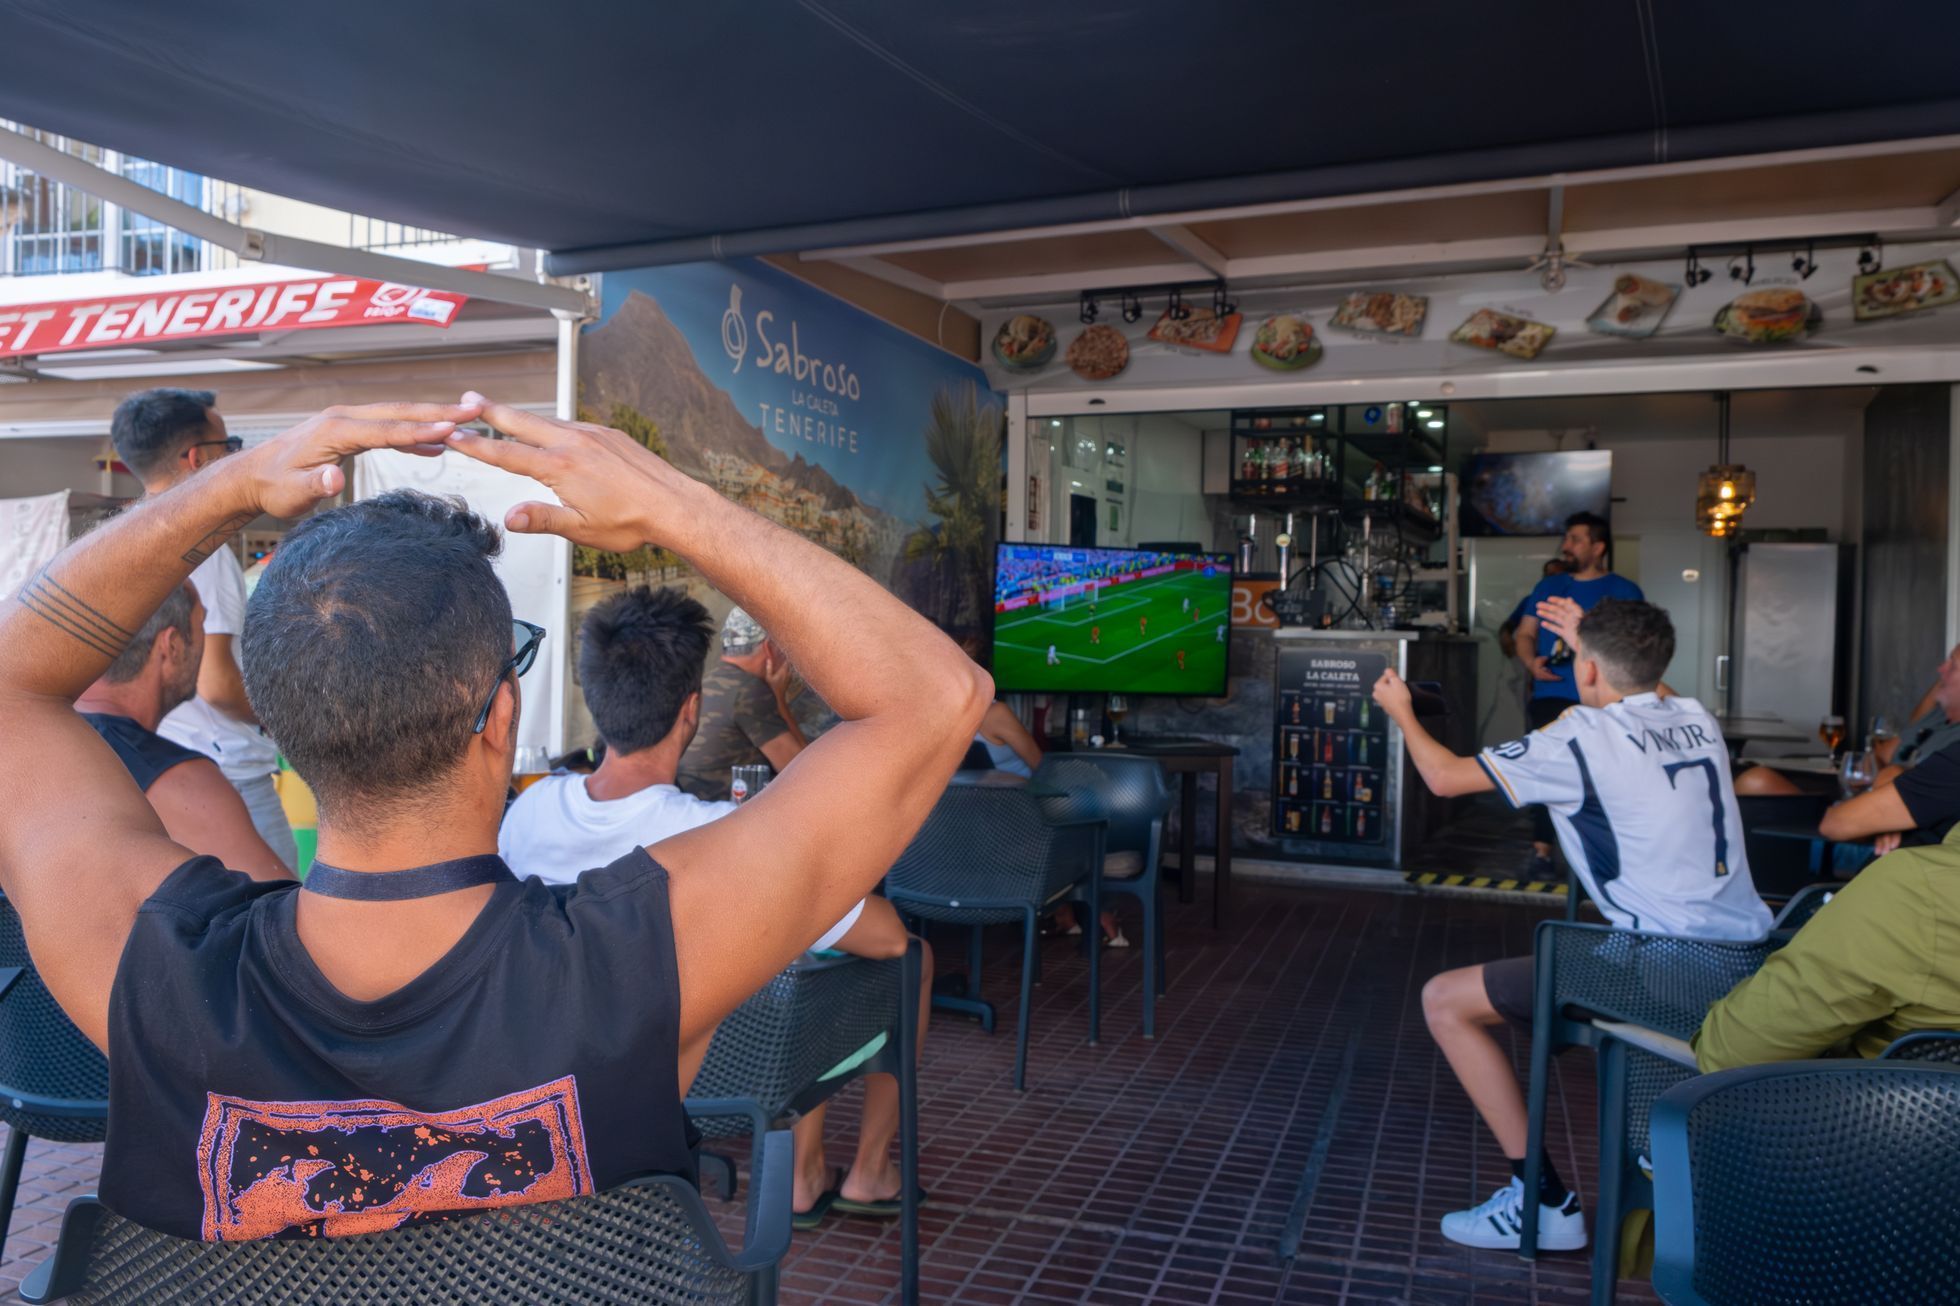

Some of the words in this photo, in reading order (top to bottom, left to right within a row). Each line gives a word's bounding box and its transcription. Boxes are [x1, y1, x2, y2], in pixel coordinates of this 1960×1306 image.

[59, 280, 358, 346] TENERIFE
[756, 310, 860, 401] Sabroso
[760, 403, 859, 453] TENERIFE
[1306, 670, 1319, 681] LA
[1321, 671, 1360, 682] CALETA
[1311, 659, 1357, 670] SABROSO
[1663, 757, 1730, 878] 7
